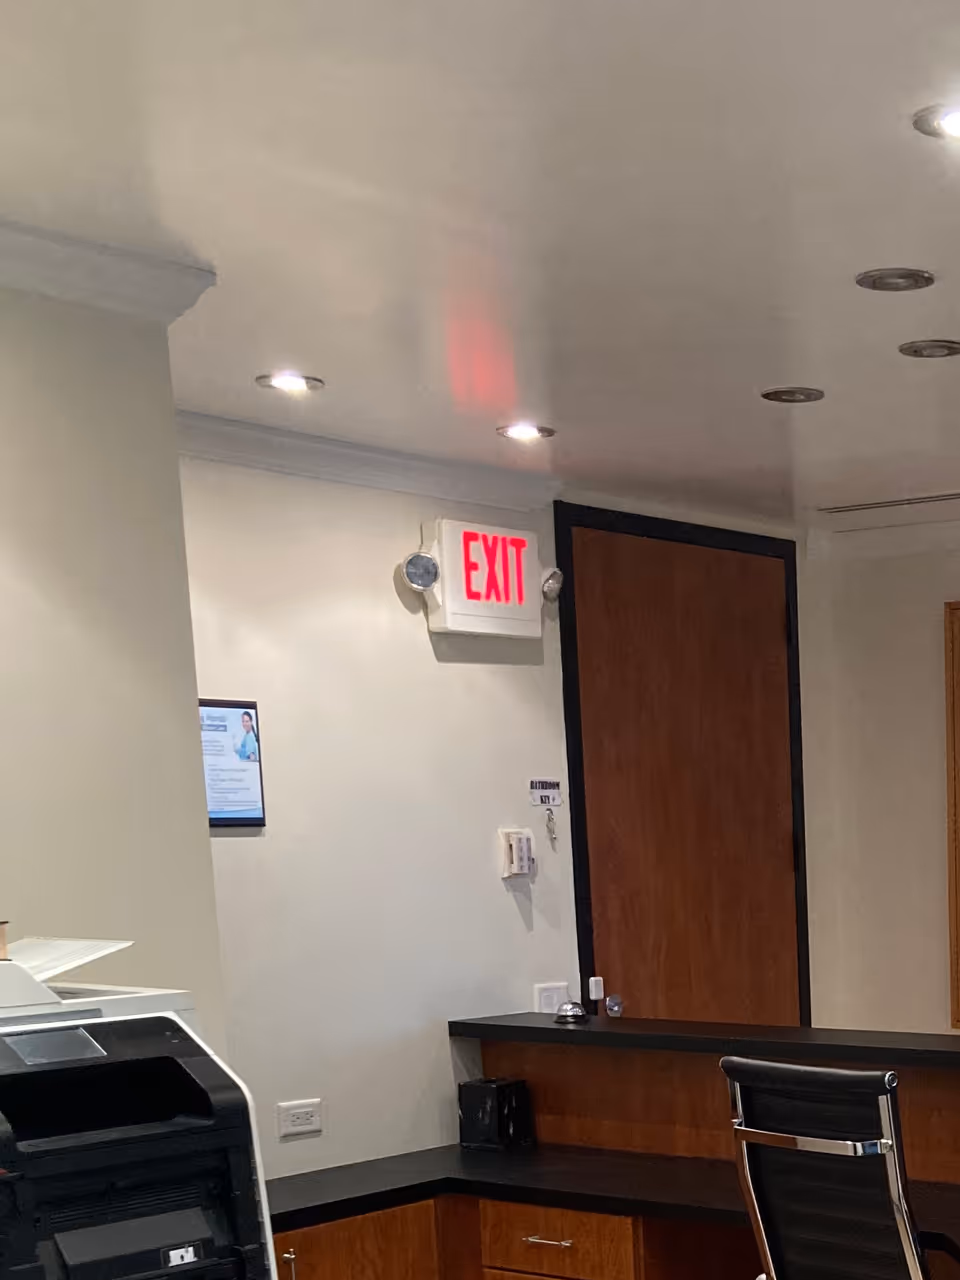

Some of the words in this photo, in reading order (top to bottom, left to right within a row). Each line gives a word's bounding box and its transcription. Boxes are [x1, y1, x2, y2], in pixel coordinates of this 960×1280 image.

[462, 530, 528, 605] EXIT
[530, 780, 561, 790] BATHROOM
[540, 795, 551, 804] KEY
